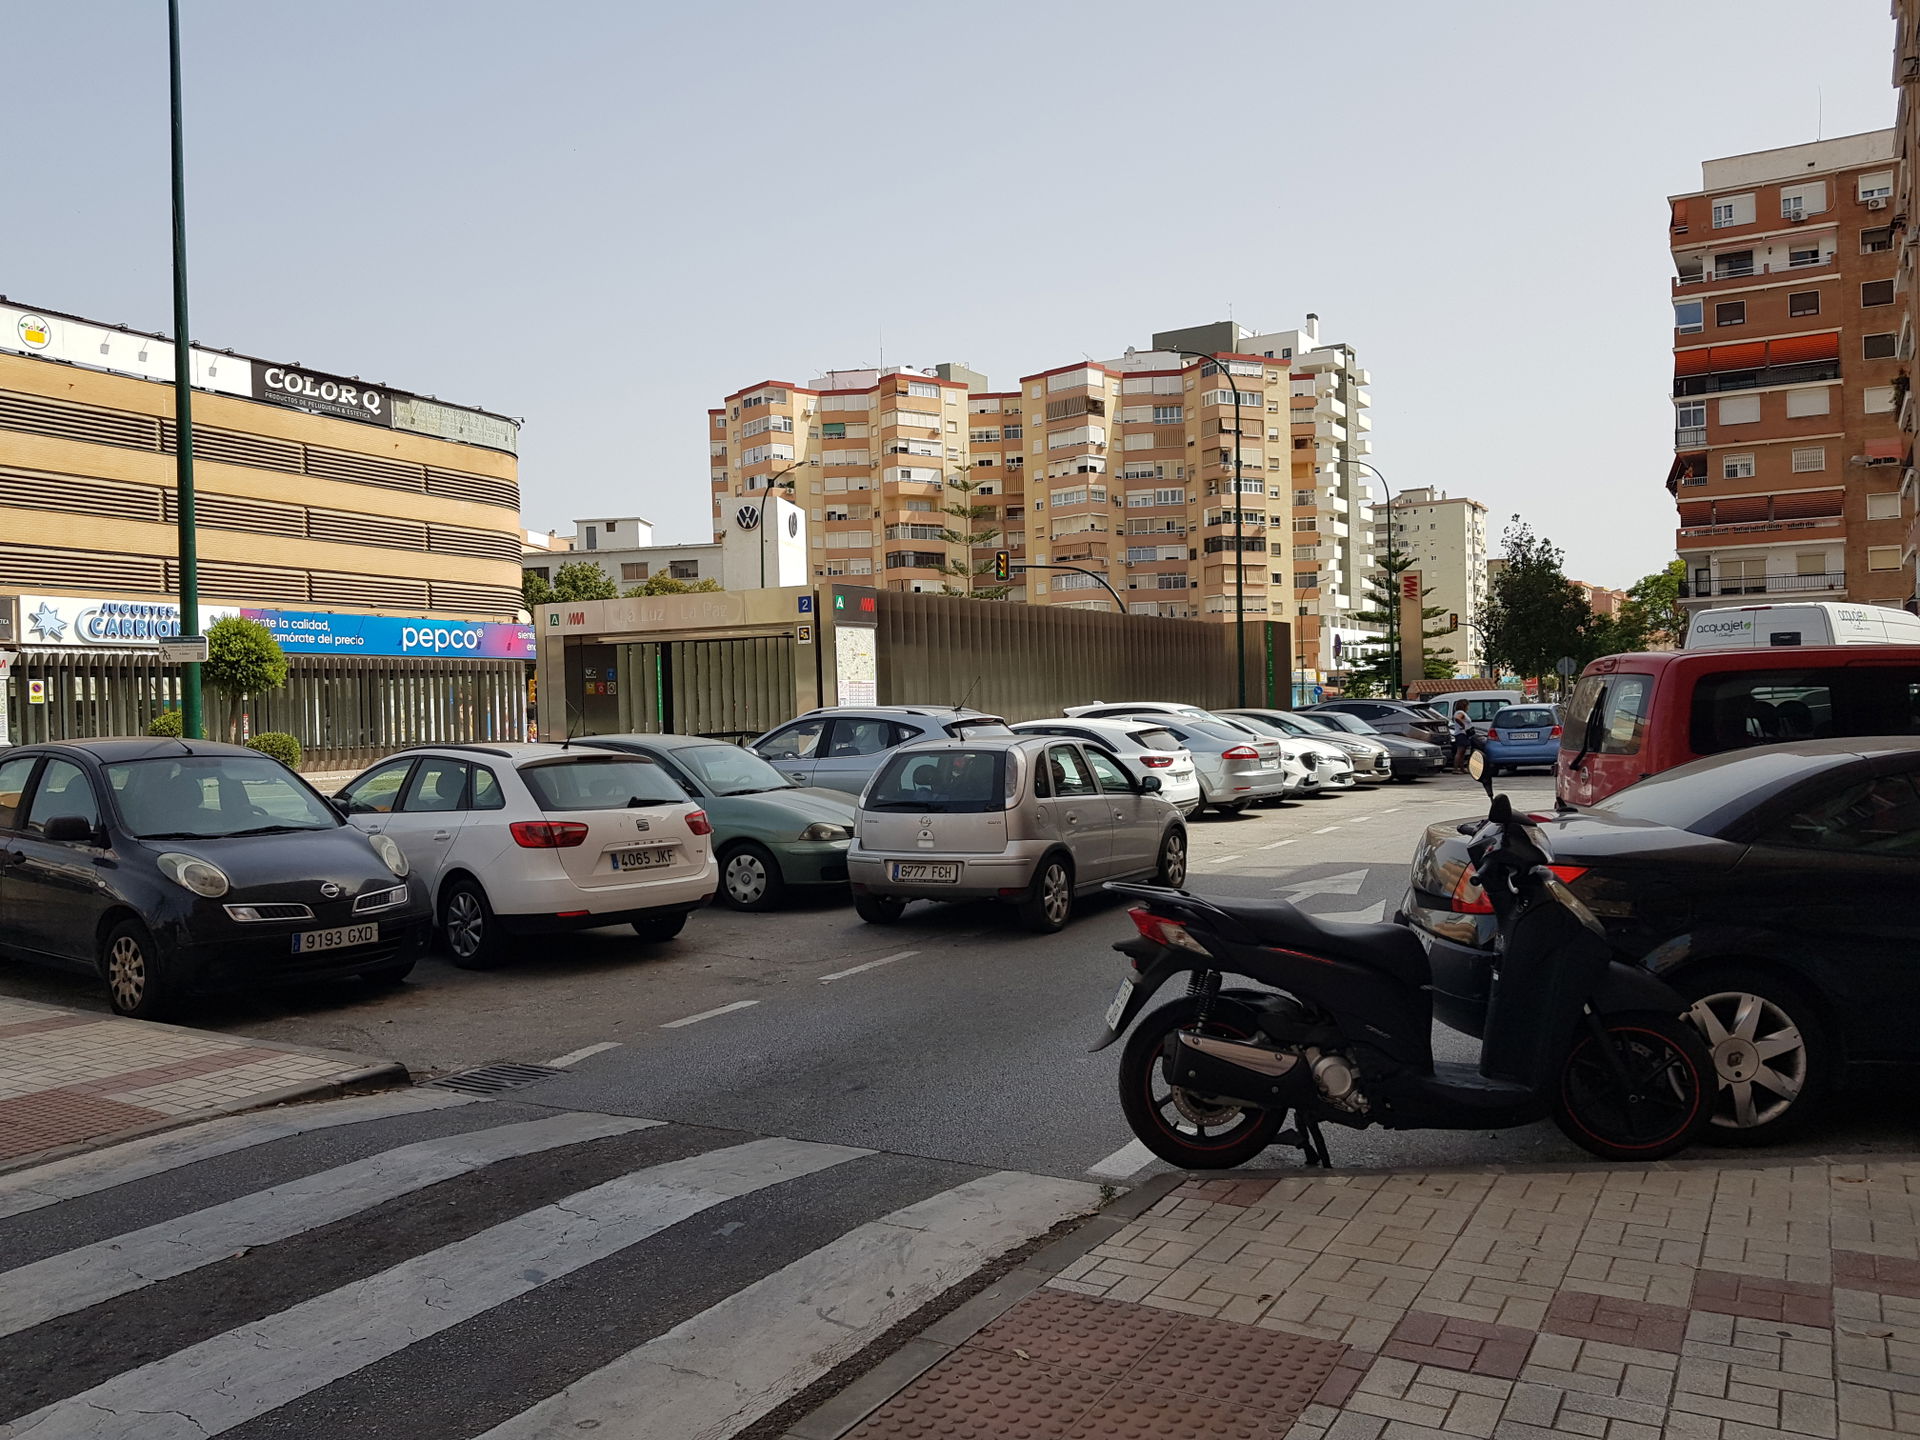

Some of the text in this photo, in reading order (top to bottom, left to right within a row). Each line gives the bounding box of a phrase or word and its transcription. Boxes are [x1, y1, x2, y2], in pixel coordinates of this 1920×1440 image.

[264, 368, 358, 405] COLOR
[264, 391, 298, 405] PRODUCTOS
[101, 602, 175, 617] JUGUETES
[801, 599, 809, 611] 2
[279, 617, 289, 629] la
[291, 619, 331, 632] calidad,
[1696, 620, 1744, 634] acquajet
[317, 633, 333, 644] del
[335, 634, 365, 647] precio
[621, 849, 673, 867] 4065 JKF
[901, 865, 952, 878] 6777 FCH
[306, 926, 373, 949] 9193 GXD
